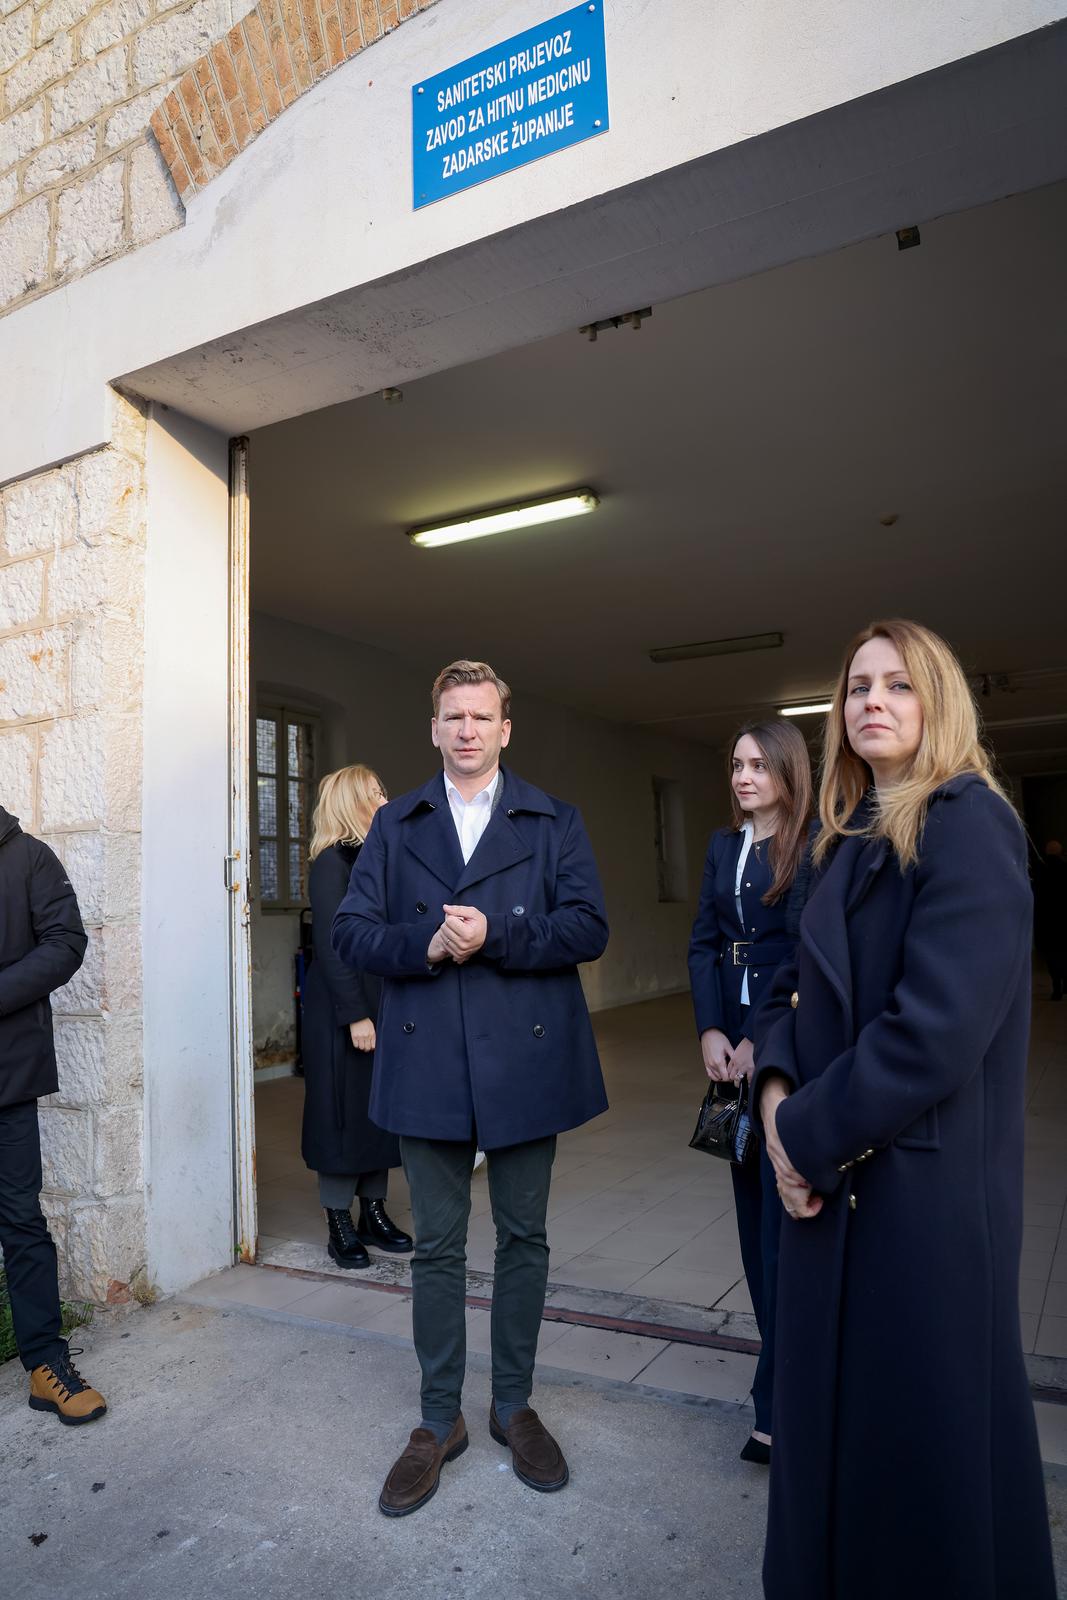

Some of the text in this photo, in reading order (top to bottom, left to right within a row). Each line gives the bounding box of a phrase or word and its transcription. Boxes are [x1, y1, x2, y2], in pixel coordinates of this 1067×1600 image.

[426, 57, 591, 152] ZAVOD ZA HITNU MEDICINU
[437, 30, 573, 113] SANITETSKI PRIJEVOZ
[442, 102, 574, 179] ZADARSKE ŽUPANIJE
